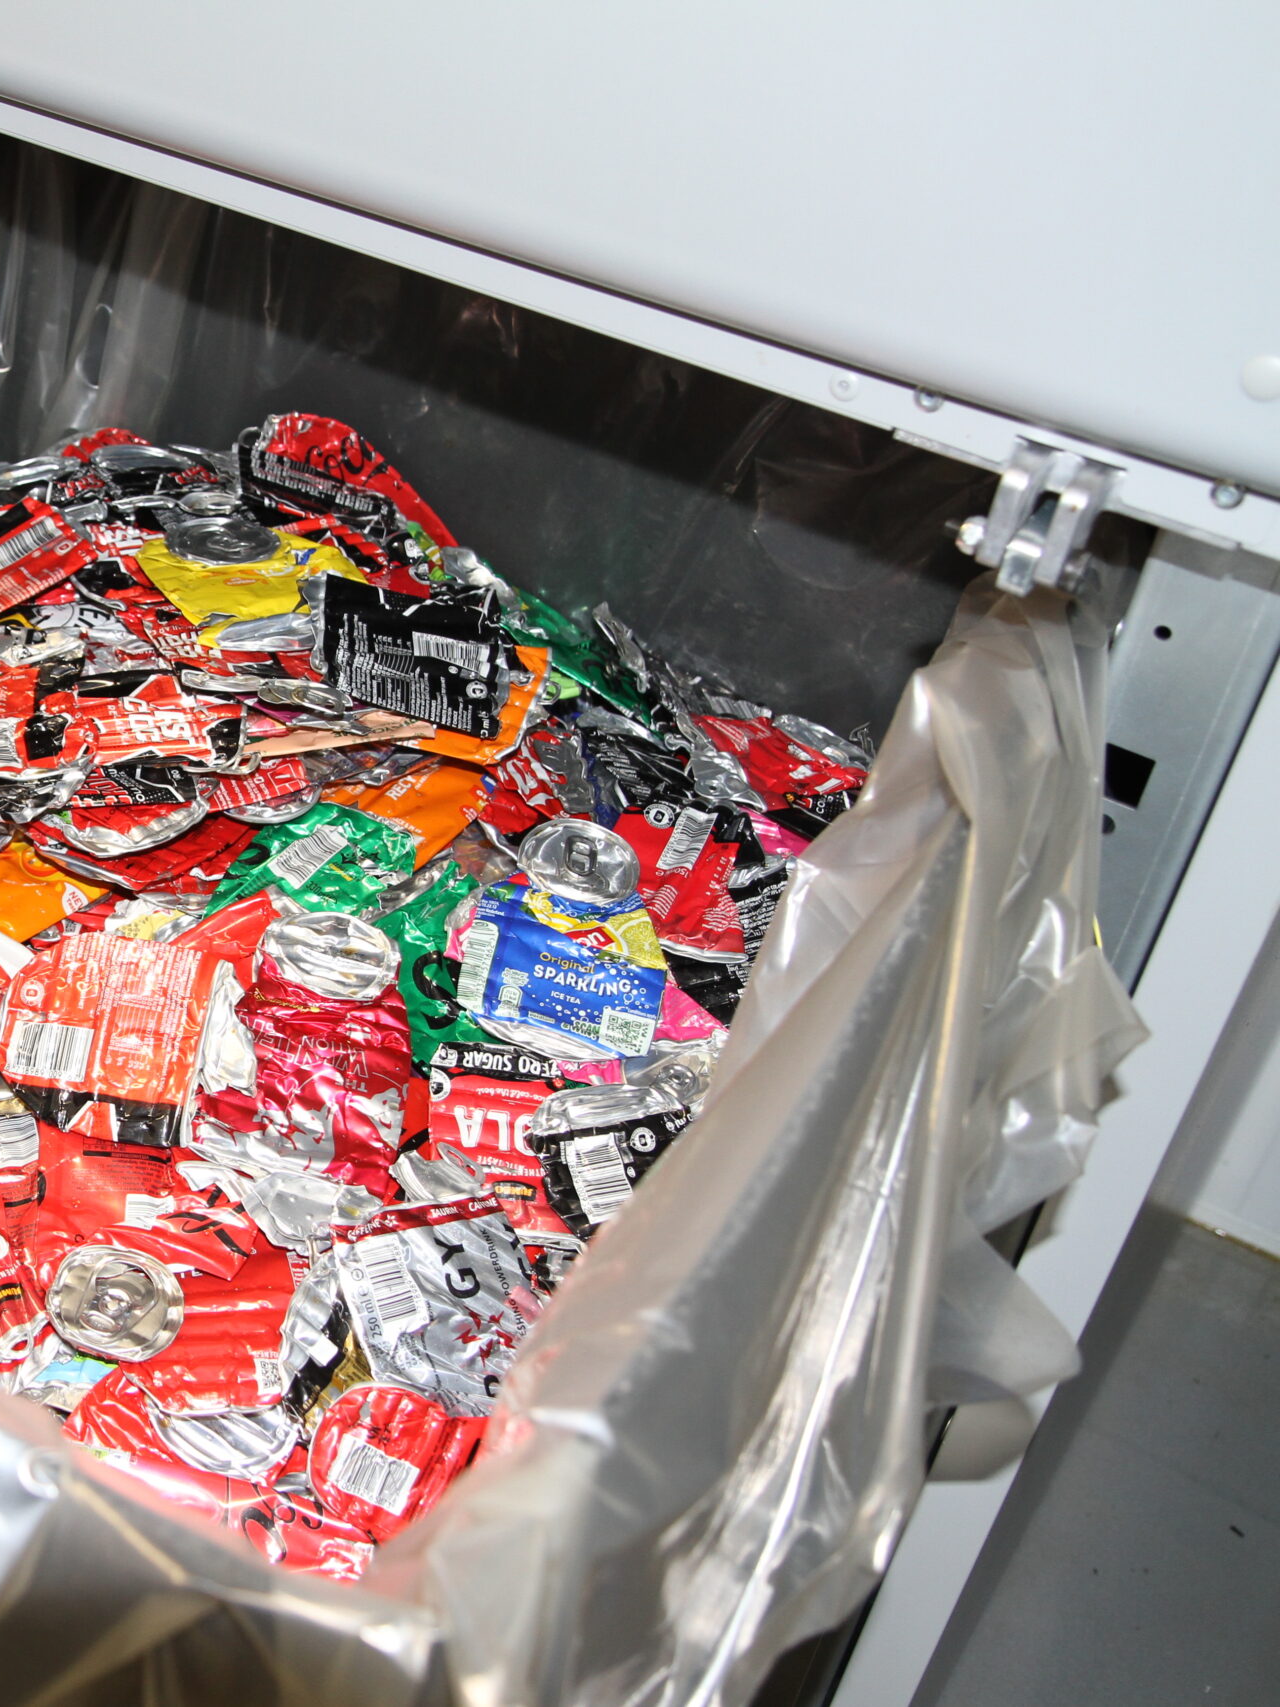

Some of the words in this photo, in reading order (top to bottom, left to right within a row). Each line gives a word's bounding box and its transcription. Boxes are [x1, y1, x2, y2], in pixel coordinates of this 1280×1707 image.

[539, 951, 597, 975] Original
[532, 963, 633, 997] SPARKLING
[550, 989, 565, 1001] ICE
[565, 992, 581, 1005] TEA
[462, 1050, 513, 1072] SUGAR
[480, 1227, 512, 1297] POWERDRINK
[367, 1316, 383, 1338] 250
